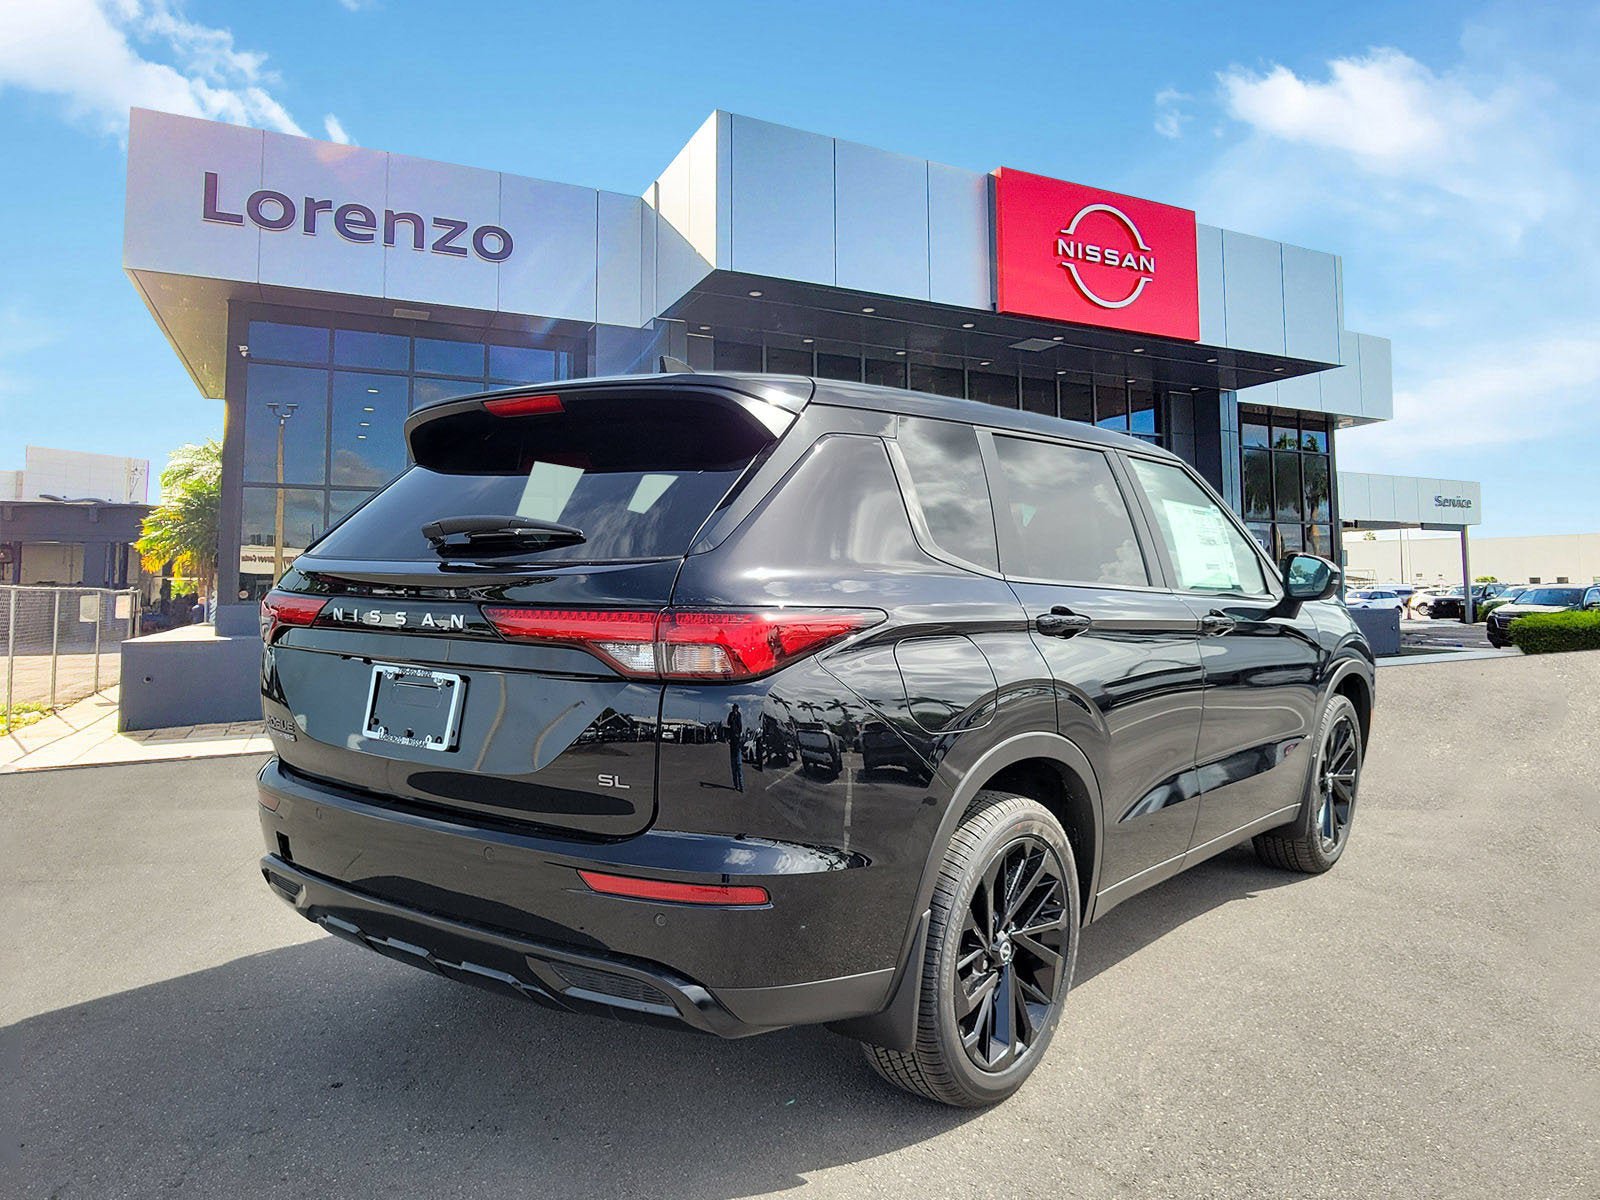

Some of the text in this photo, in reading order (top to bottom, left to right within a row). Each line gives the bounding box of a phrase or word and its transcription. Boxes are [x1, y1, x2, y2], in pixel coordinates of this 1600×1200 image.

[202, 171, 514, 262] Lorenzo
[1057, 238, 1155, 273] NISSAN
[1434, 495, 1472, 508] Service
[333, 607, 464, 629] NISSAN
[597, 774, 631, 789] SL
